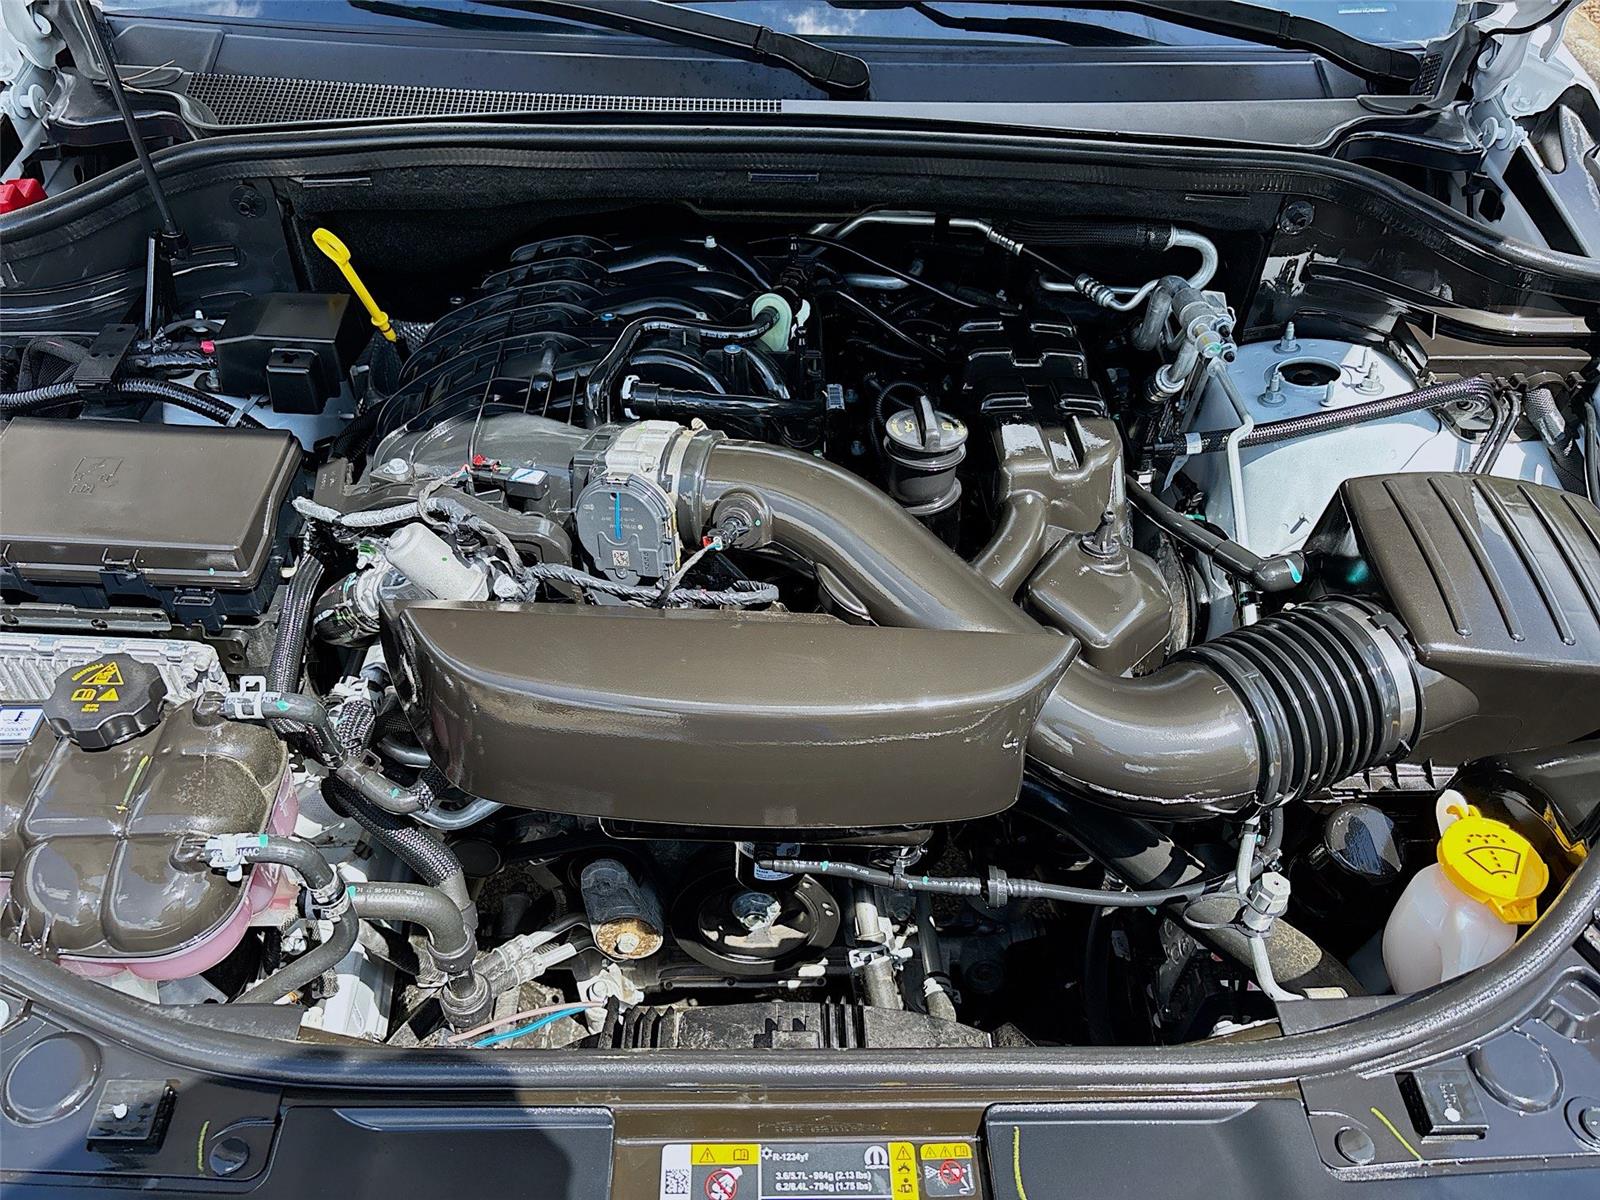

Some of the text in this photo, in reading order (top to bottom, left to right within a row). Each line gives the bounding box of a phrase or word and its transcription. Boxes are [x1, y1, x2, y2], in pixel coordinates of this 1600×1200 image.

[772, 1152, 809, 1163] R-1234yf
[775, 1171, 808, 1180] 3.6/5.7L
[835, 1171, 855, 1181] (2.13
[855, 1171, 872, 1181] lbs)
[835, 1181, 855, 1192] (1.75
[856, 1181, 873, 1192] lbs)
